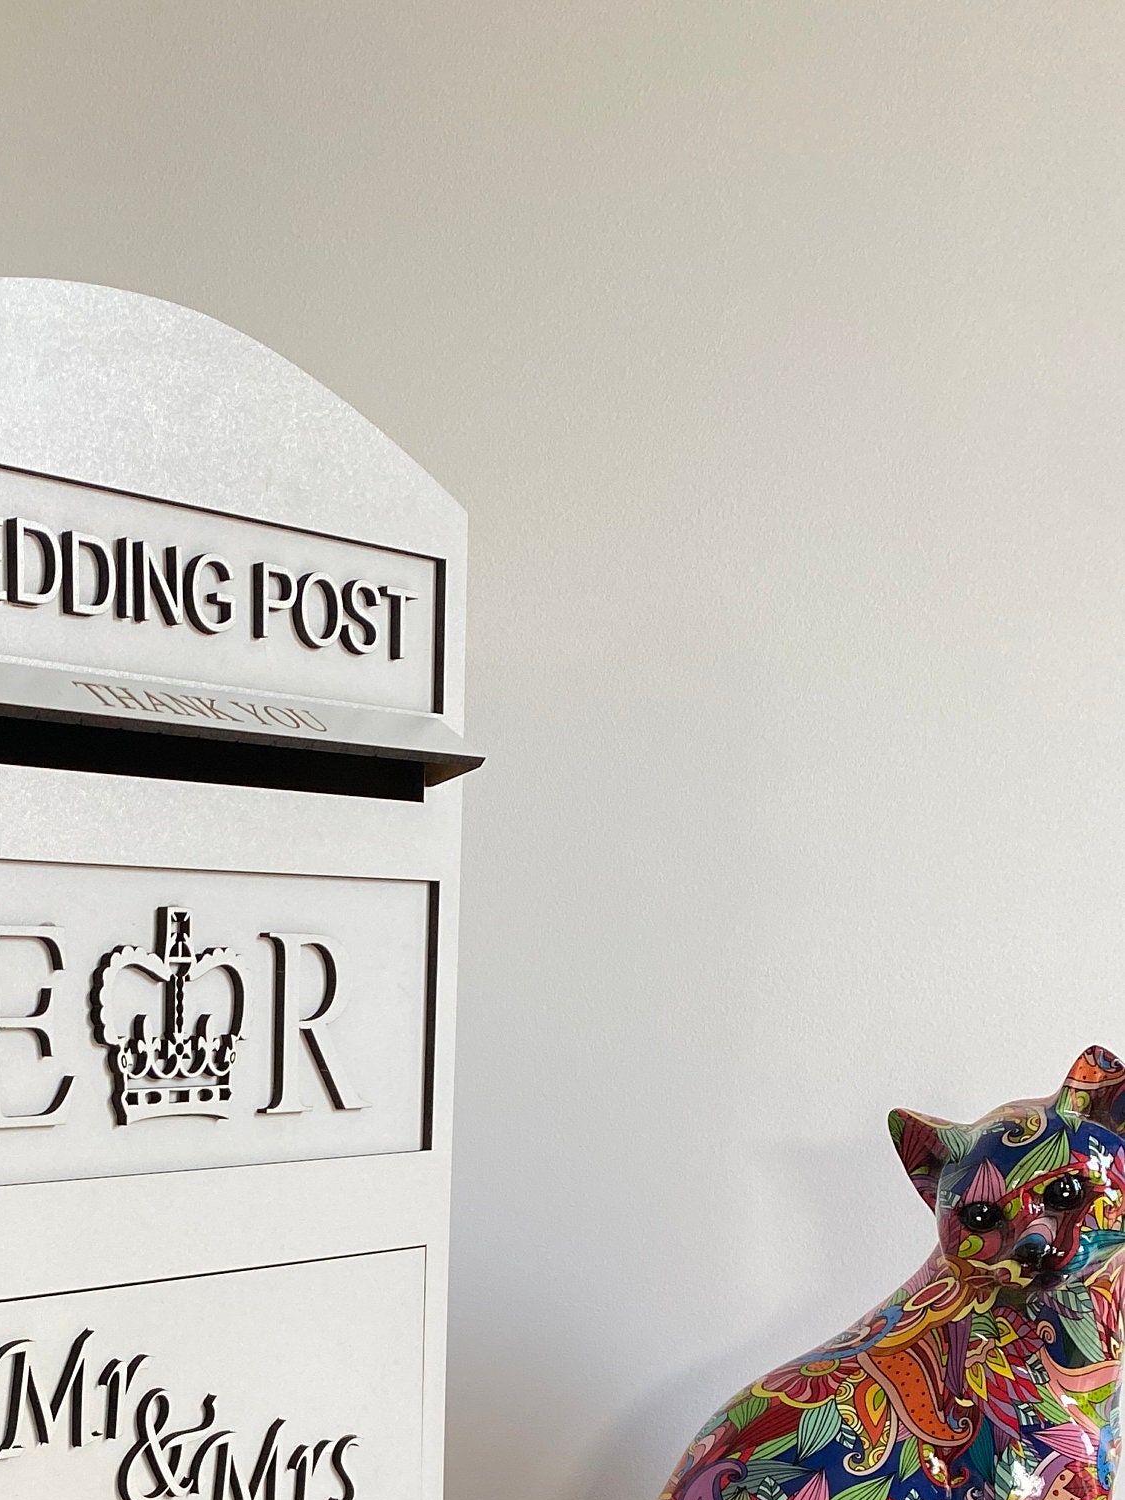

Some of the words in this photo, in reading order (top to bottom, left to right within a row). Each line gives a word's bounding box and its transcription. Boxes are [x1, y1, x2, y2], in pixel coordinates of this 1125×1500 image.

[252, 561, 418, 660] POST
[71, 681, 245, 723] THANK
[230, 701, 328, 732] YOU
[255, 932, 372, 1115] R
